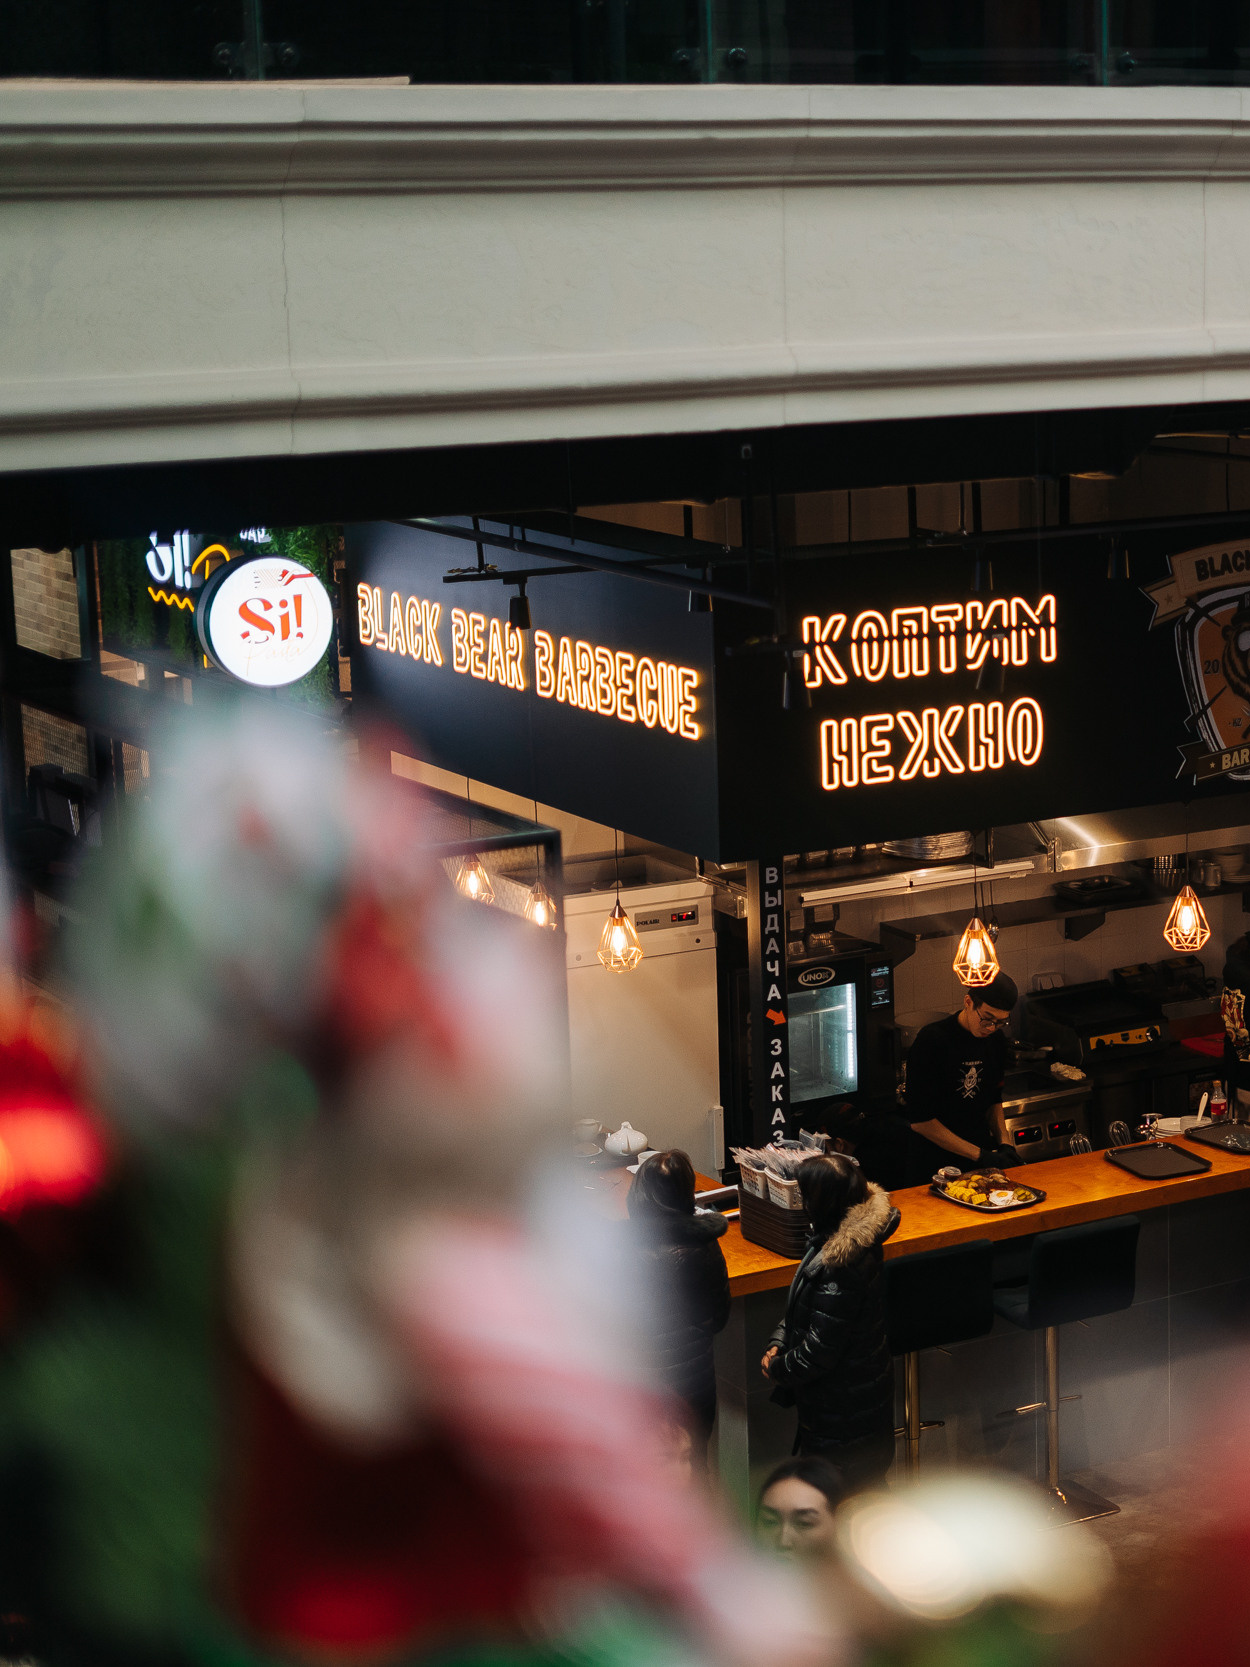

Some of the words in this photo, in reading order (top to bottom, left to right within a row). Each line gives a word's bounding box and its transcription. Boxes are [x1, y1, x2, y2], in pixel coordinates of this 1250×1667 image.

[238, 593, 304, 644] Si!
[357, 582, 443, 667] BLACK
[450, 607, 525, 692] BEAR
[534, 629, 700, 741] BARBECUE
[801, 593, 1058, 689] КОПТИМ
[1204, 659, 1220, 674] 20
[820, 696, 1044, 791] НЕЖНО
[764, 866, 783, 1001] ВЫДАЧА
